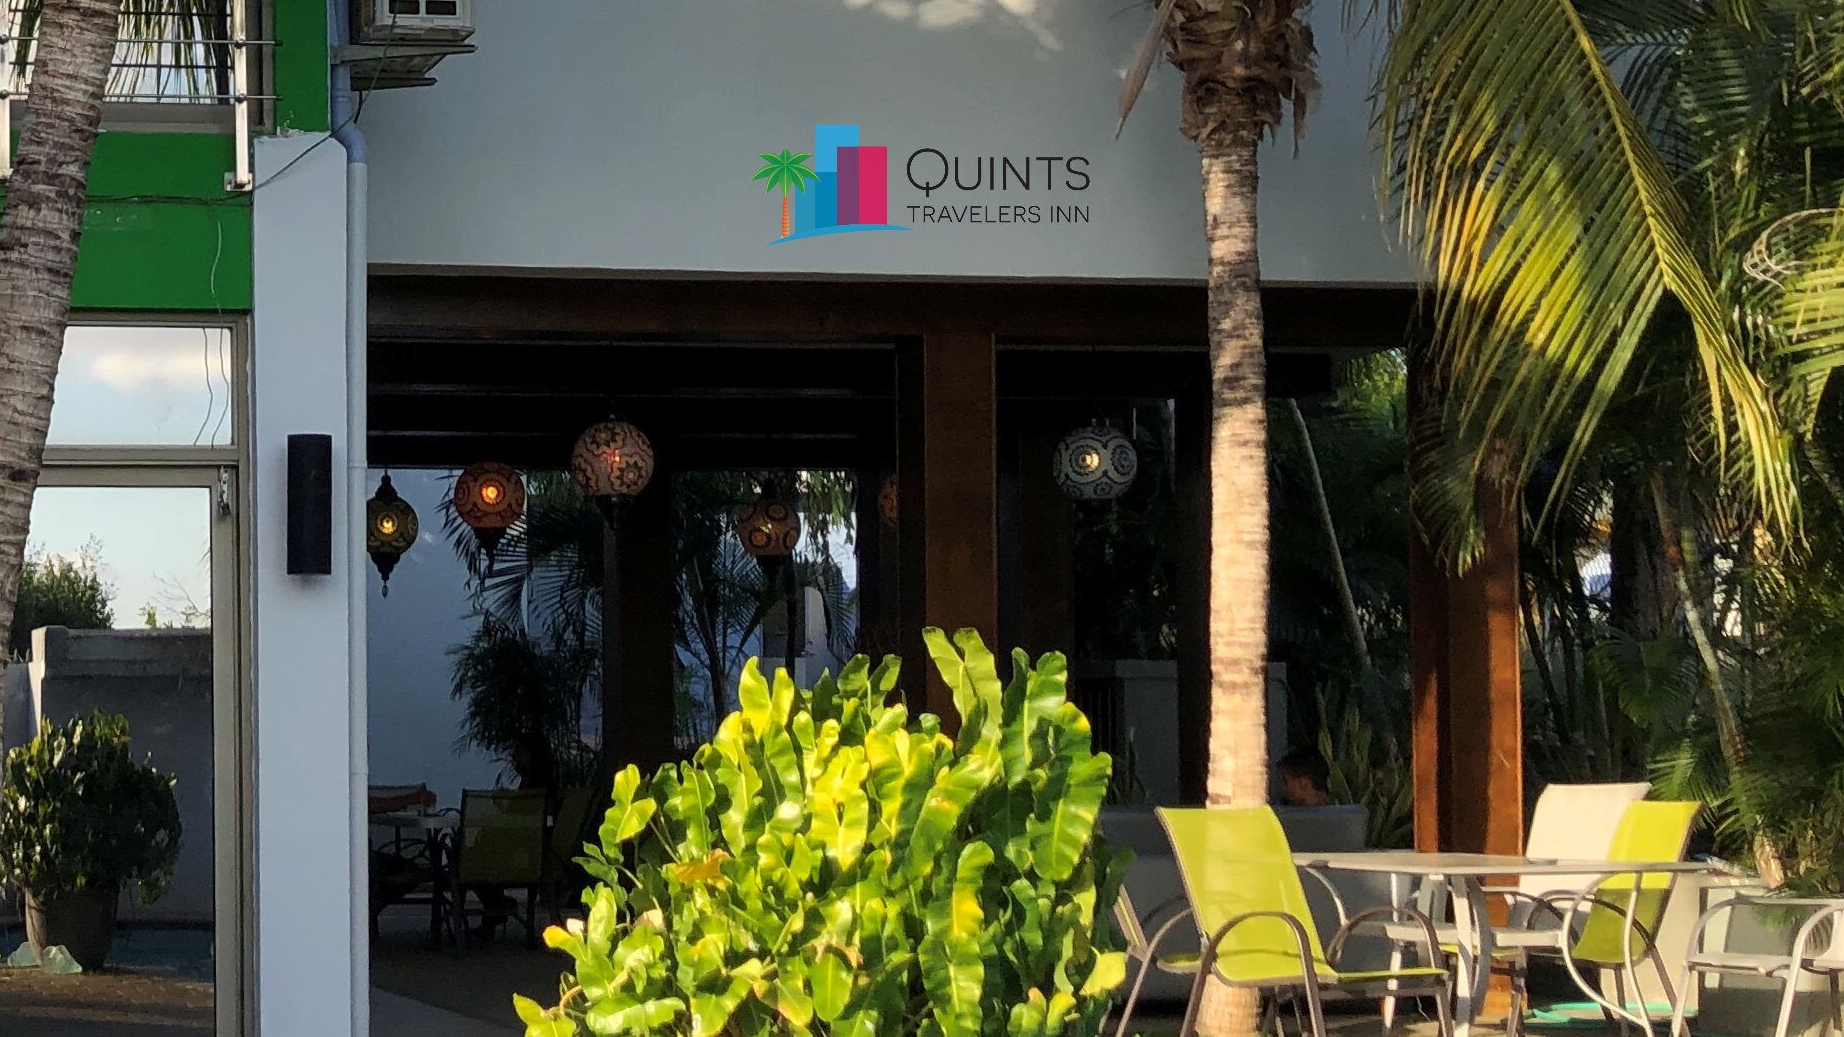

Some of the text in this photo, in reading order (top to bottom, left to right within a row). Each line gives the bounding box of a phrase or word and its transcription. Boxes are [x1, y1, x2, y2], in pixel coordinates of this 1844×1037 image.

[906, 147, 1091, 198] QUINTS
[906, 205, 1090, 224] TRAVELERS INN
